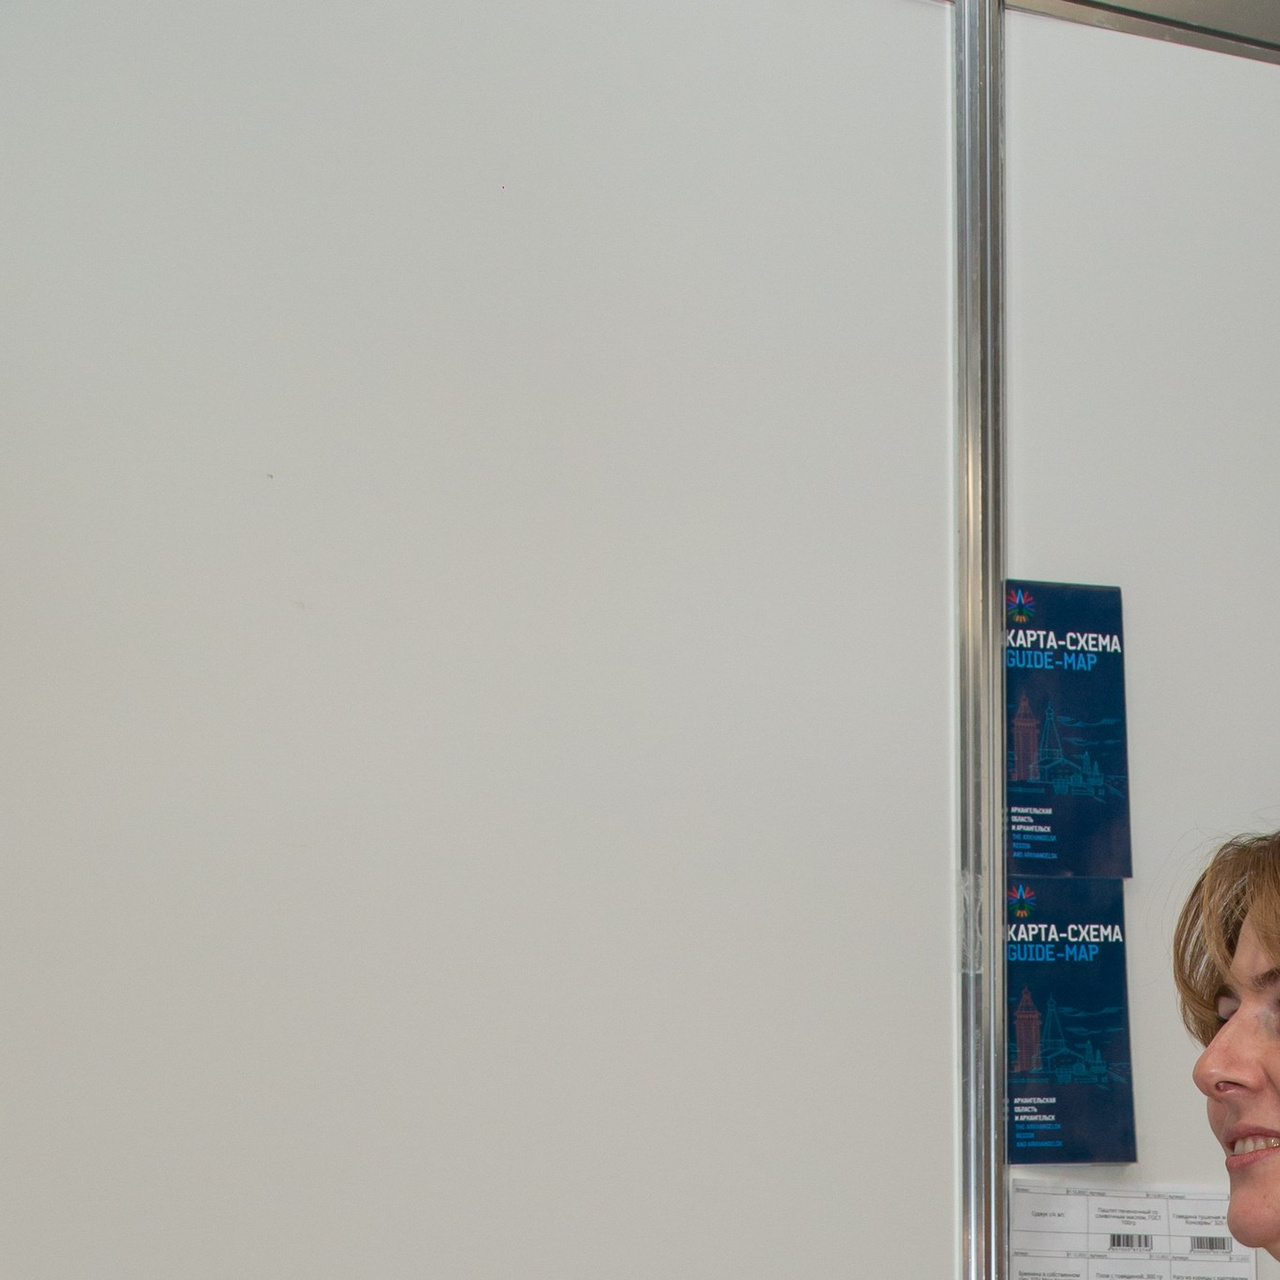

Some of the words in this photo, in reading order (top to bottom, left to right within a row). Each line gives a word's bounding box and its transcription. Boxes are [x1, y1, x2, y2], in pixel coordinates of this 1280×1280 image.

[1006, 629, 1122, 652] КАРТА-СХЕМА
[1006, 650, 1097, 671] GUIDE-MAP
[1007, 924, 1123, 942] КАРТА-СХЕМА
[1007, 944, 1099, 962] GUIDE-MAP
